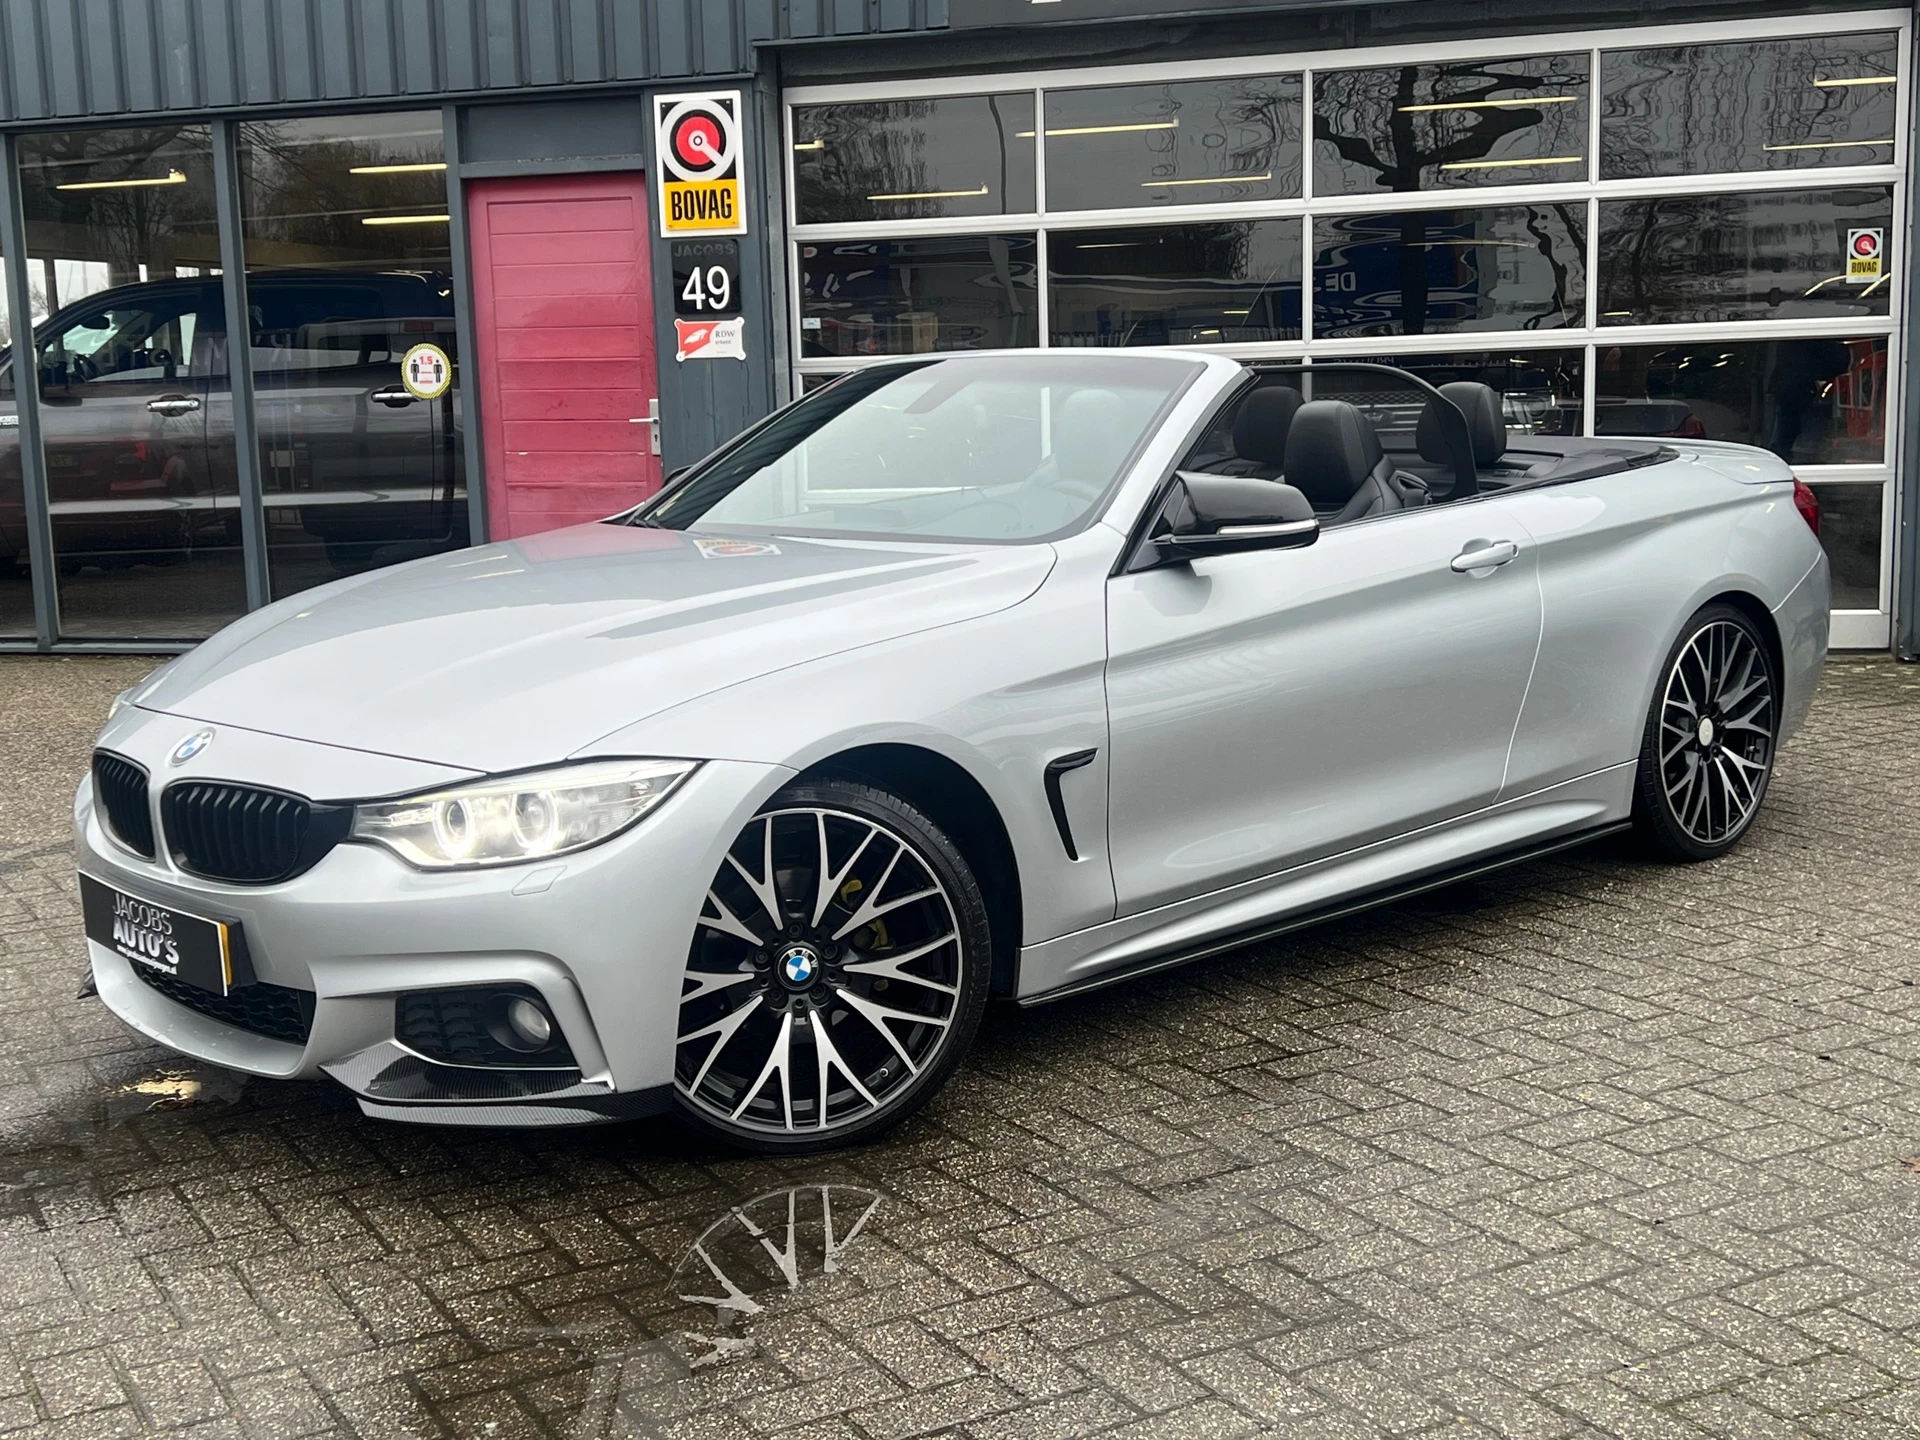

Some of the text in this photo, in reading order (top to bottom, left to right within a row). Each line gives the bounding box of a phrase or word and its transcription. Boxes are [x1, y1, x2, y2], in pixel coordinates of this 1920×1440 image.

[670, 188, 732, 221] BOVAG
[674, 243, 736, 257] JACOBS
[1851, 261, 1877, 273] BOVAG
[682, 265, 730, 310] 49
[715, 330, 736, 338] RDW
[419, 356, 433, 365] 1.5
[112, 892, 173, 935] JACOBS
[113, 915, 180, 965] AUTO'S
